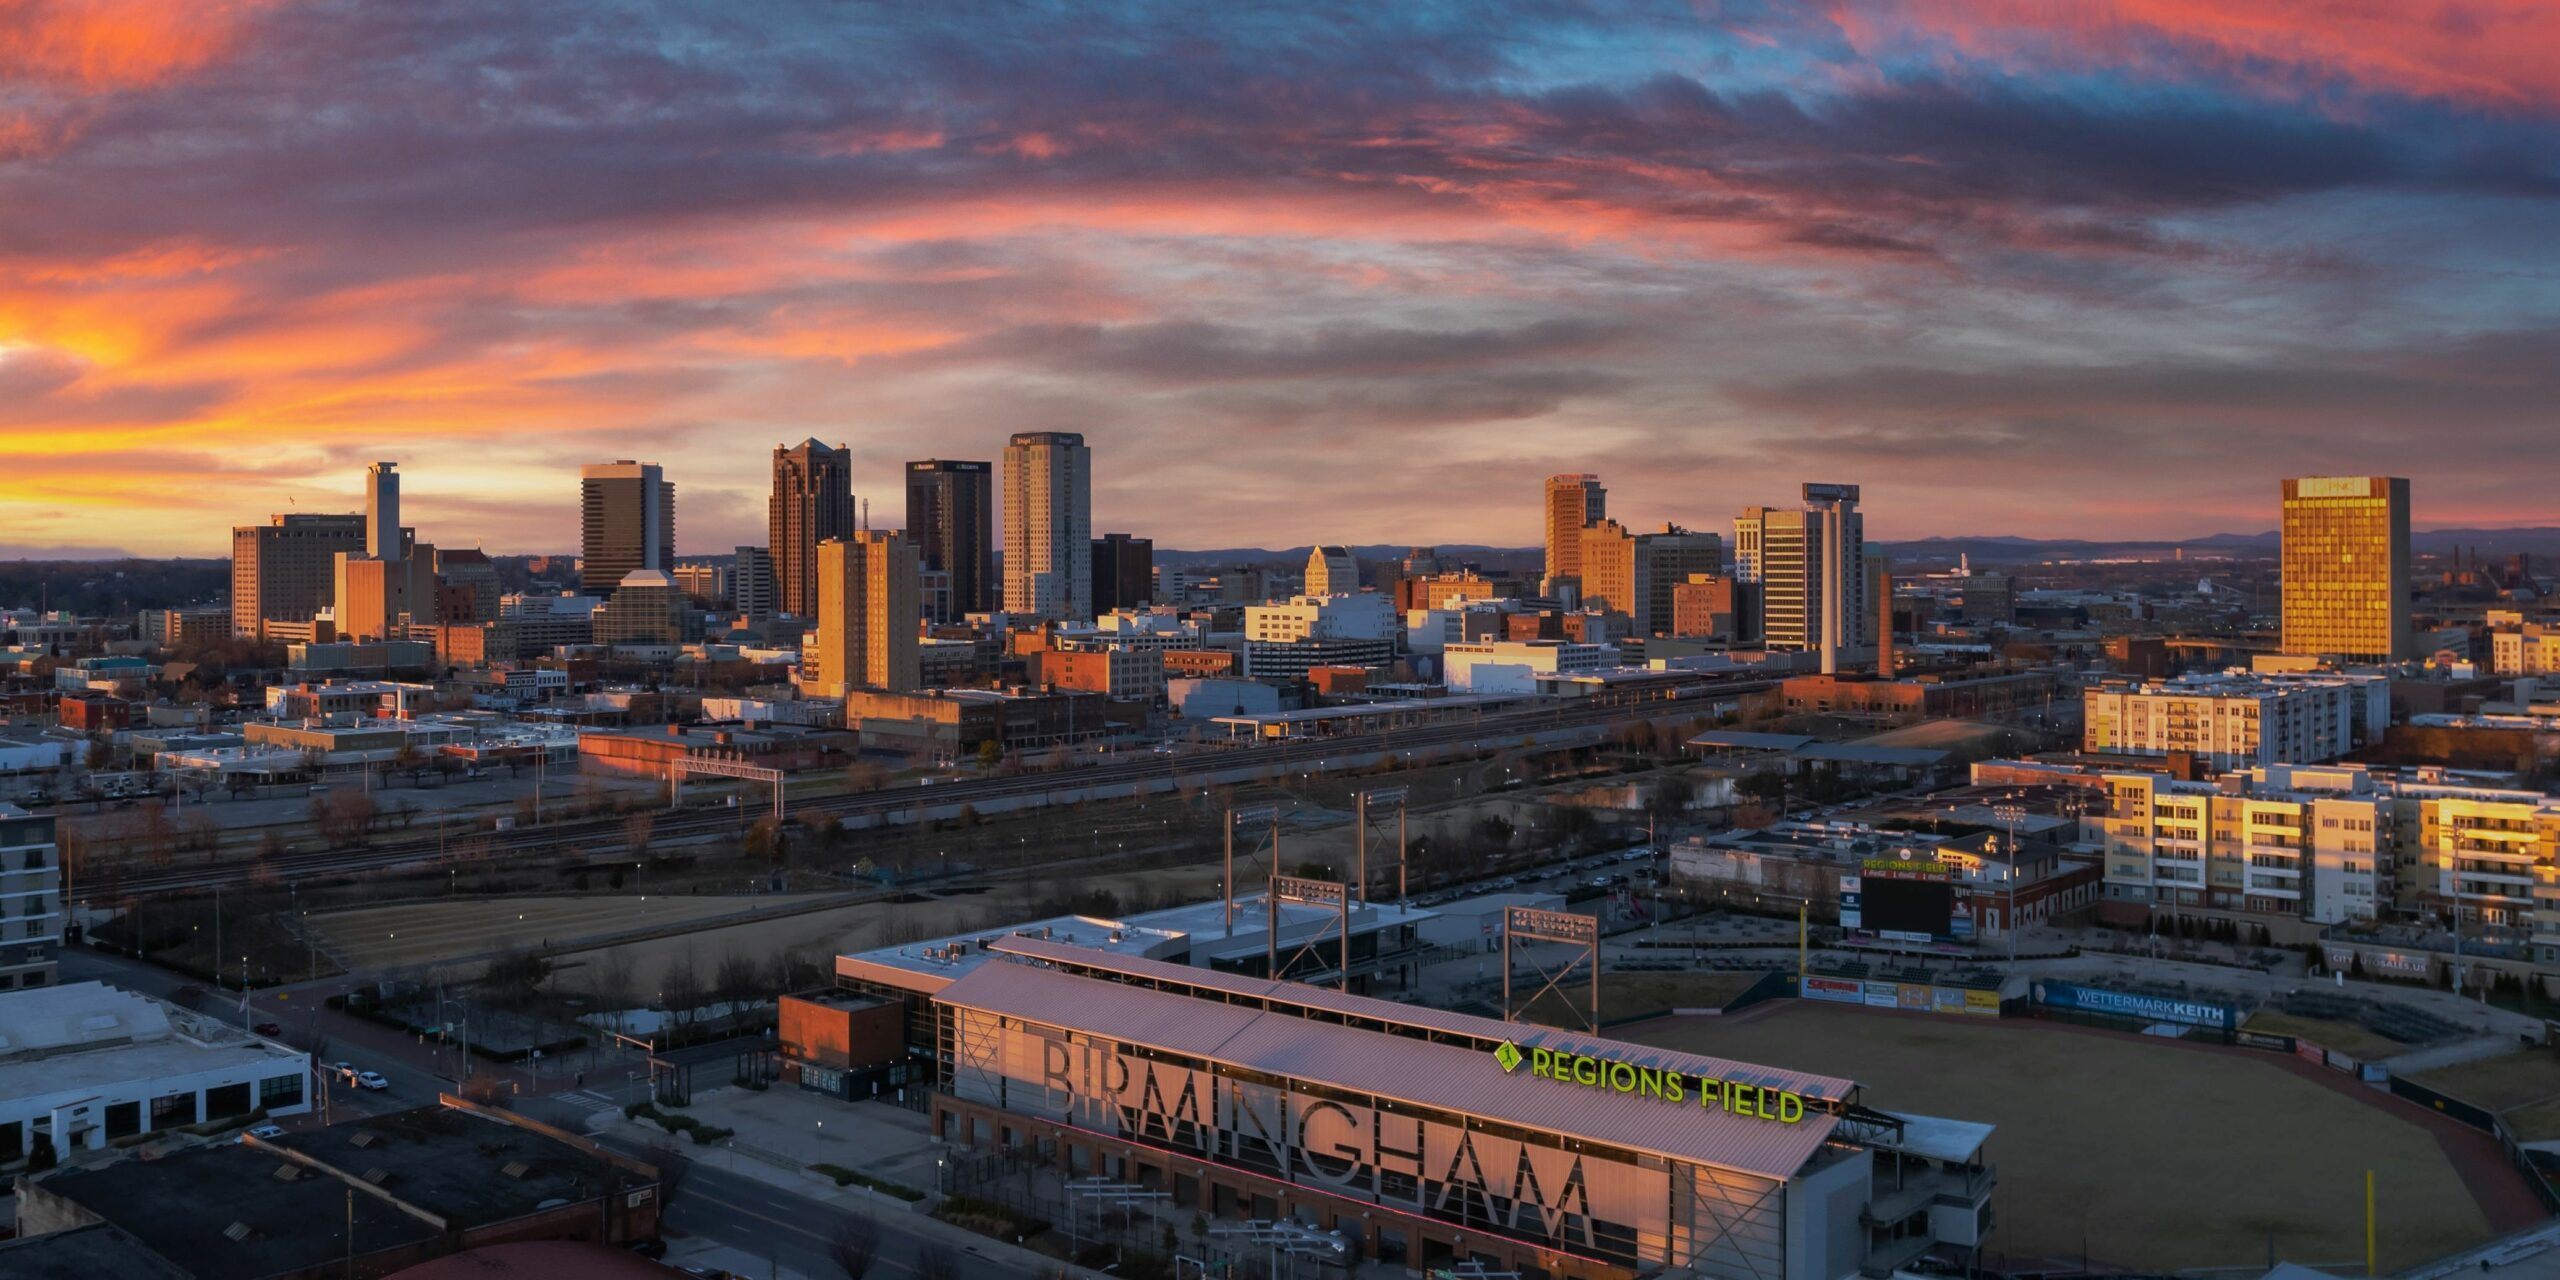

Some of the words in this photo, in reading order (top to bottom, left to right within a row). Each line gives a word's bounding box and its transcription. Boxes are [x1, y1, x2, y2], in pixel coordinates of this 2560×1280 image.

[1863, 859, 1913, 871] REGIONS
[1916, 862, 1947, 873] FIELD
[1532, 1047, 1685, 1103] REGIONS
[1701, 1077, 1804, 1124] FIELD
[1043, 1038, 1595, 1248] BIRMINGHAM
